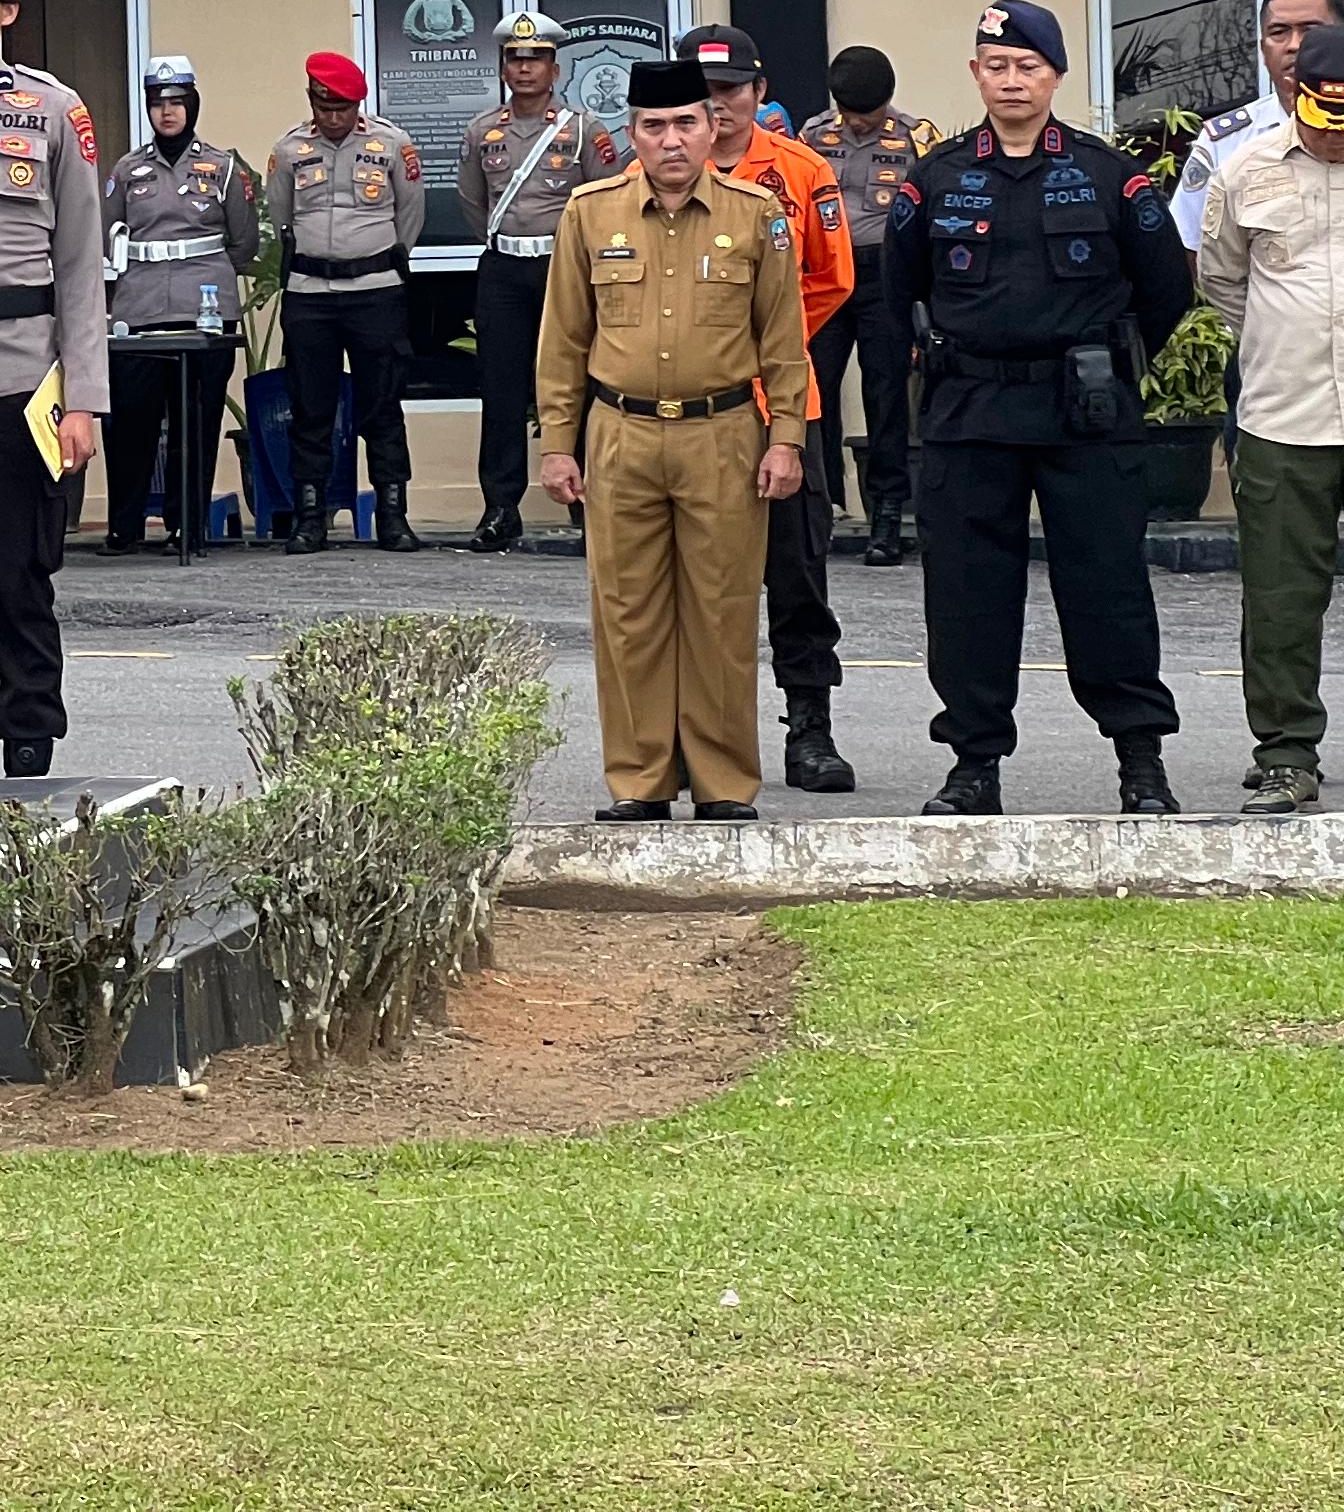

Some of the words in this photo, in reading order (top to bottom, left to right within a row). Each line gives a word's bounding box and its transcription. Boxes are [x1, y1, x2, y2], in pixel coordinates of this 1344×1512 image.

[598, 25, 657, 42] SABHARA
[410, 49, 477, 62] TRIBRATA
[443, 68, 496, 78] INDONESIA
[548, 143, 573, 153] OLRI
[355, 153, 390, 167] POLRI
[872, 154, 907, 165] POLRI
[944, 193, 993, 209] ENCEP
[1044, 188, 1097, 207] POLRI
